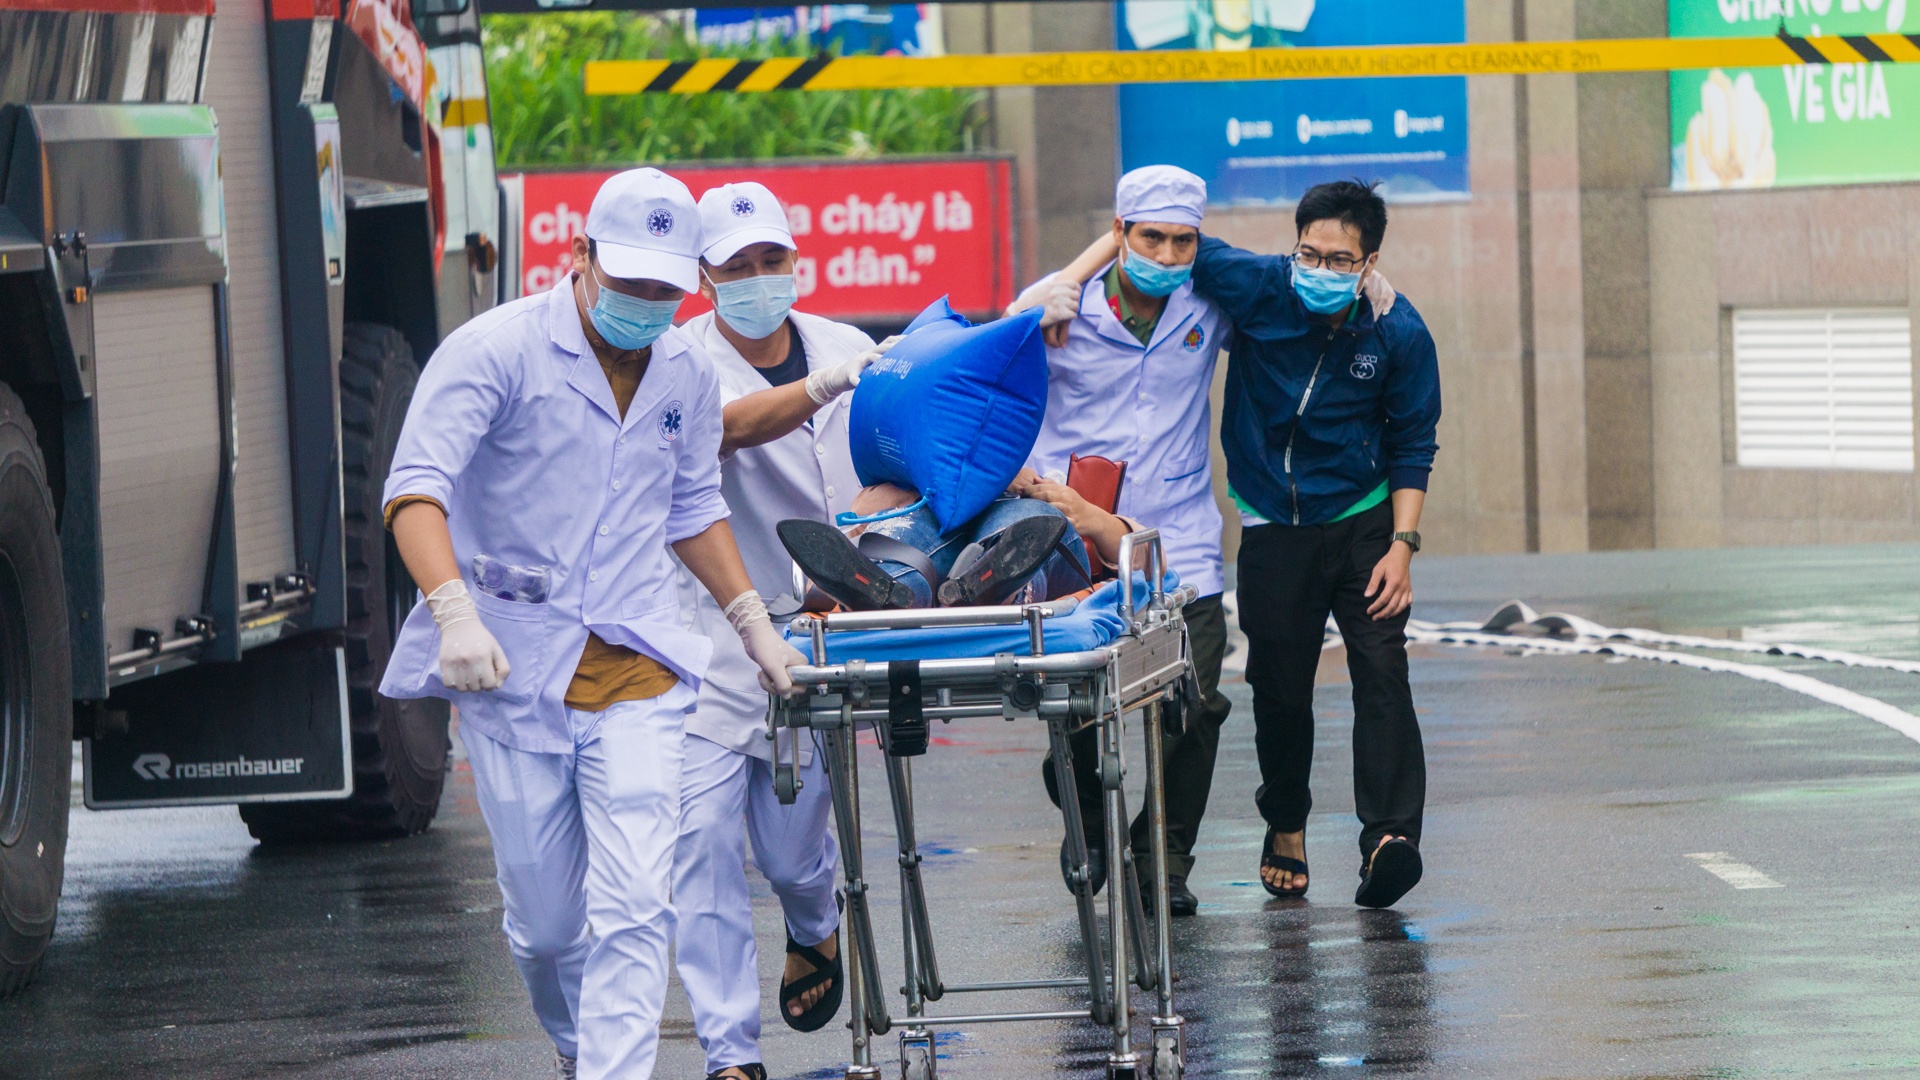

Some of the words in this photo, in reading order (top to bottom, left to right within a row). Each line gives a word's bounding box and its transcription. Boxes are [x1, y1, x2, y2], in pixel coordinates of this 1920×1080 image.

[1087, 58, 1137, 80] CAO
[1216, 56, 1248, 77] 2m
[1262, 54, 1362, 74] MAXIMUM
[1369, 52, 1438, 72] HEIGHT
[1445, 49, 1564, 71] CLEARANCE
[1571, 48, 1602, 69] 2m
[820, 191, 927, 241] cháy
[932, 189, 974, 231] là
[1354, 353, 1378, 364] GUCCI
[175, 754, 304, 779] rosenbauer
